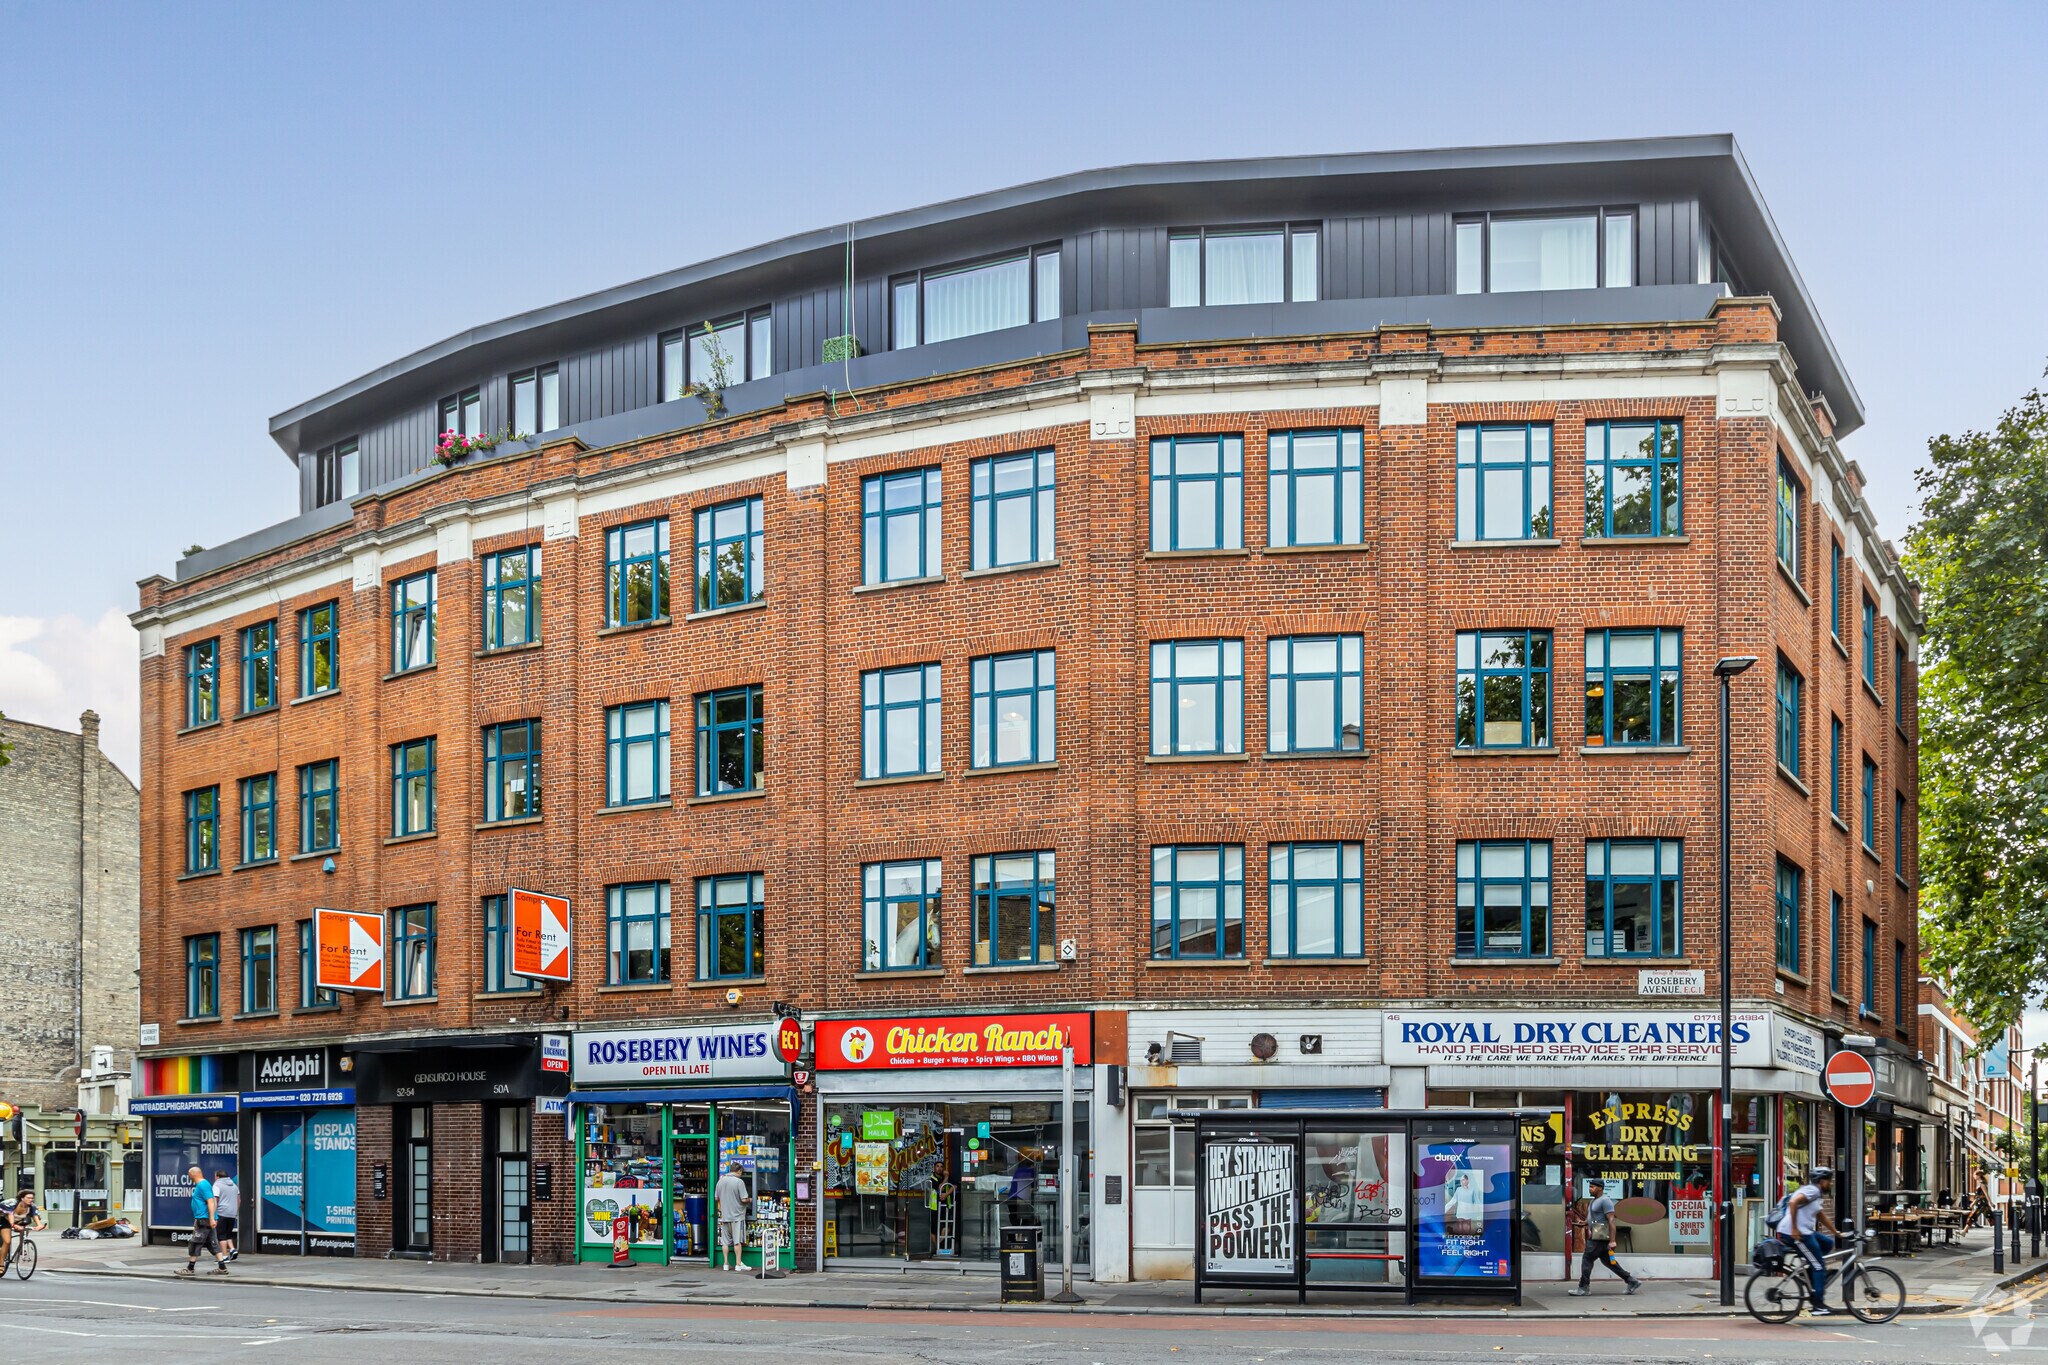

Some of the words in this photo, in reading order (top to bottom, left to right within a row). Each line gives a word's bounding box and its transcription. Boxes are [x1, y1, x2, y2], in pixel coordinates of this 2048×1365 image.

[515, 892, 550, 905] Compton
[516, 926, 532, 937] For
[535, 930, 556, 942] Rent
[320, 943, 338, 953] For
[342, 945, 367, 955] Rent
[1647, 977, 1698, 985] ROSEBERY
[886, 1026, 978, 1054] Chicken
[984, 1023, 1063, 1051] Ranch
[1401, 1022, 1500, 1044] ROYAL
[1513, 1022, 1577, 1044] DRY
[1581, 1021, 1751, 1045] CLEANERS
[549, 1038, 561, 1047] OFF
[781, 1029, 799, 1050] EC1
[544, 1046, 567, 1057] LICENCE
[588, 1036, 694, 1065] ROSEBERY
[696, 1031, 768, 1060] WINES
[1417, 1045, 1466, 1054] HAND
[1470, 1045, 1544, 1054] FINISHED
[890, 1056, 914, 1065] Chicken
[923, 1056, 945, 1066] Burger
[952, 1055, 969, 1065] Wrap
[975, 1055, 993, 1064] Spicy
[995, 1054, 1015, 1064] Wings
[1022, 1054, 1036, 1064] BBQ
[1038, 1053, 1058, 1063] Wings
[1465, 1054, 1483, 1062] THE
[1487, 1054, 1512, 1062] CARE
[1516, 1054, 1531, 1062] WE
[1536, 1054, 1559, 1062] TAKE
[1563, 1054, 1587, 1062] THAT
[1591, 1054, 1626, 1062] MAKES
[1630, 1054, 1648, 1062] THE
[1652, 1054, 1708, 1062] DIFFERENCE
[260, 1053, 320, 1082] Adelphi
[546, 1060, 564, 1069] OPEN
[642, 1066, 667, 1076] OPEN
[669, 1065, 687, 1075] TILL
[689, 1064, 710, 1075] LATE
[414, 1072, 455, 1083] GENSURCO
[457, 1071, 487, 1082] HOUSE
[396, 1087, 415, 1097] 52-54
[493, 1084, 510, 1094] 50A
[299, 1093, 311, 1101] 020
[312, 1092, 327, 1101] 7278
[327, 1092, 343, 1101] 6926
[864, 1113, 893, 1128] حلال
[1588, 1102, 1694, 1132] EXPRESS
[201, 1129, 238, 1142] DIGITAL
[314, 1123, 355, 1136] DISPLAY
[1619, 1125, 1663, 1143] DRY
[201, 1143, 238, 1154] PRINTING
[314, 1137, 355, 1150] STANDS
[1434, 1152, 1462, 1162] durex
[1583, 1144, 1698, 1162] CLEANING
[1209, 1146, 1232, 1180] HEY
[1233, 1145, 1291, 1176] STRAIGHT
[155, 1174, 179, 1186] VINYL
[180, 1174, 196, 1185] CU
[264, 1172, 302, 1183] POSTERS
[1601, 1171, 1629, 1180] HAND
[1631, 1171, 1681, 1180] FINISHING
[264, 1185, 302, 1196] BANNERS
[1209, 1173, 1255, 1213] WHITE
[1258, 1167, 1291, 1199] MEN
[1671, 1201, 1708, 1210] SPECIAL
[593, 1211, 612, 1221] WINE
[1210, 1204, 1255, 1235] PASS
[1260, 1192, 1291, 1226] THE
[1675, 1210, 1704, 1219] OFFER
[316, 1239, 355, 1248] adelphigraphics
[1210, 1223, 1291, 1260] POWER!
[1463, 1249, 1490, 1257] RIGHT
